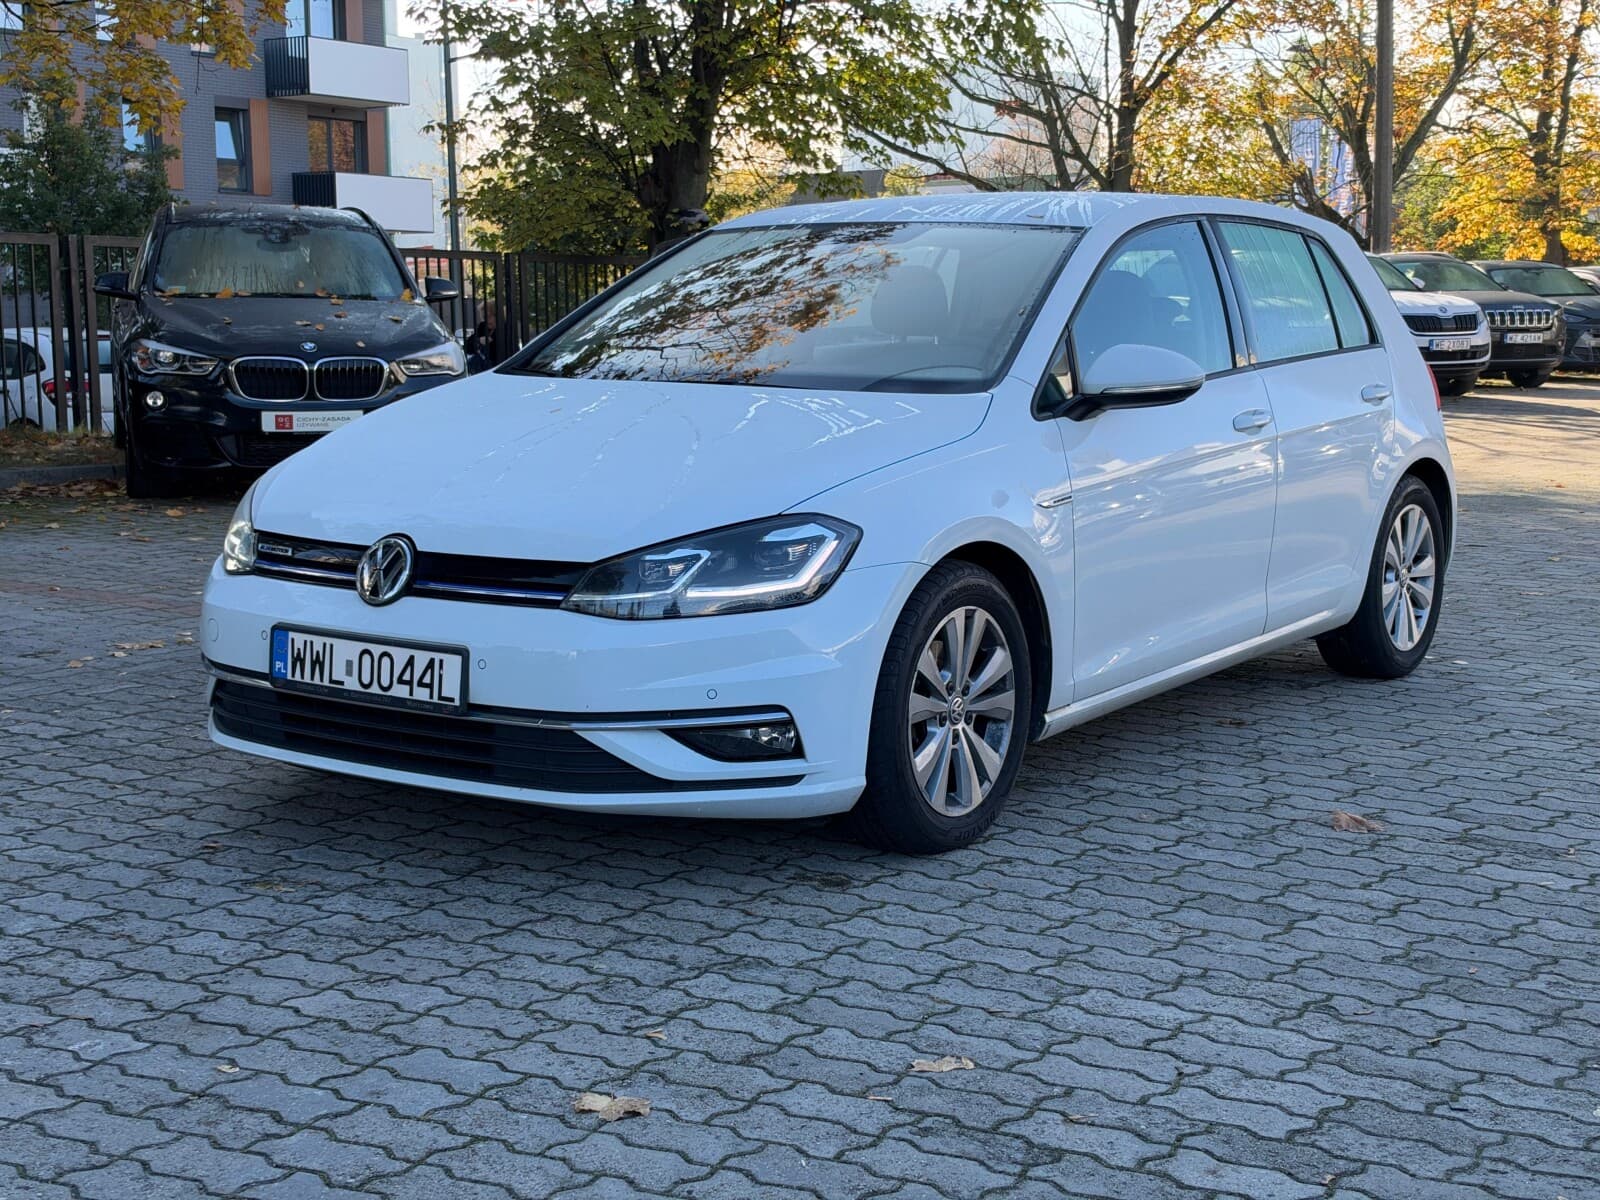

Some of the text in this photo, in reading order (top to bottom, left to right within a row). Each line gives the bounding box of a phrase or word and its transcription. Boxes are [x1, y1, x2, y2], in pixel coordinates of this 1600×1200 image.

[275, 661, 287, 673] PL
[291, 637, 456, 704] WWL 0044L
